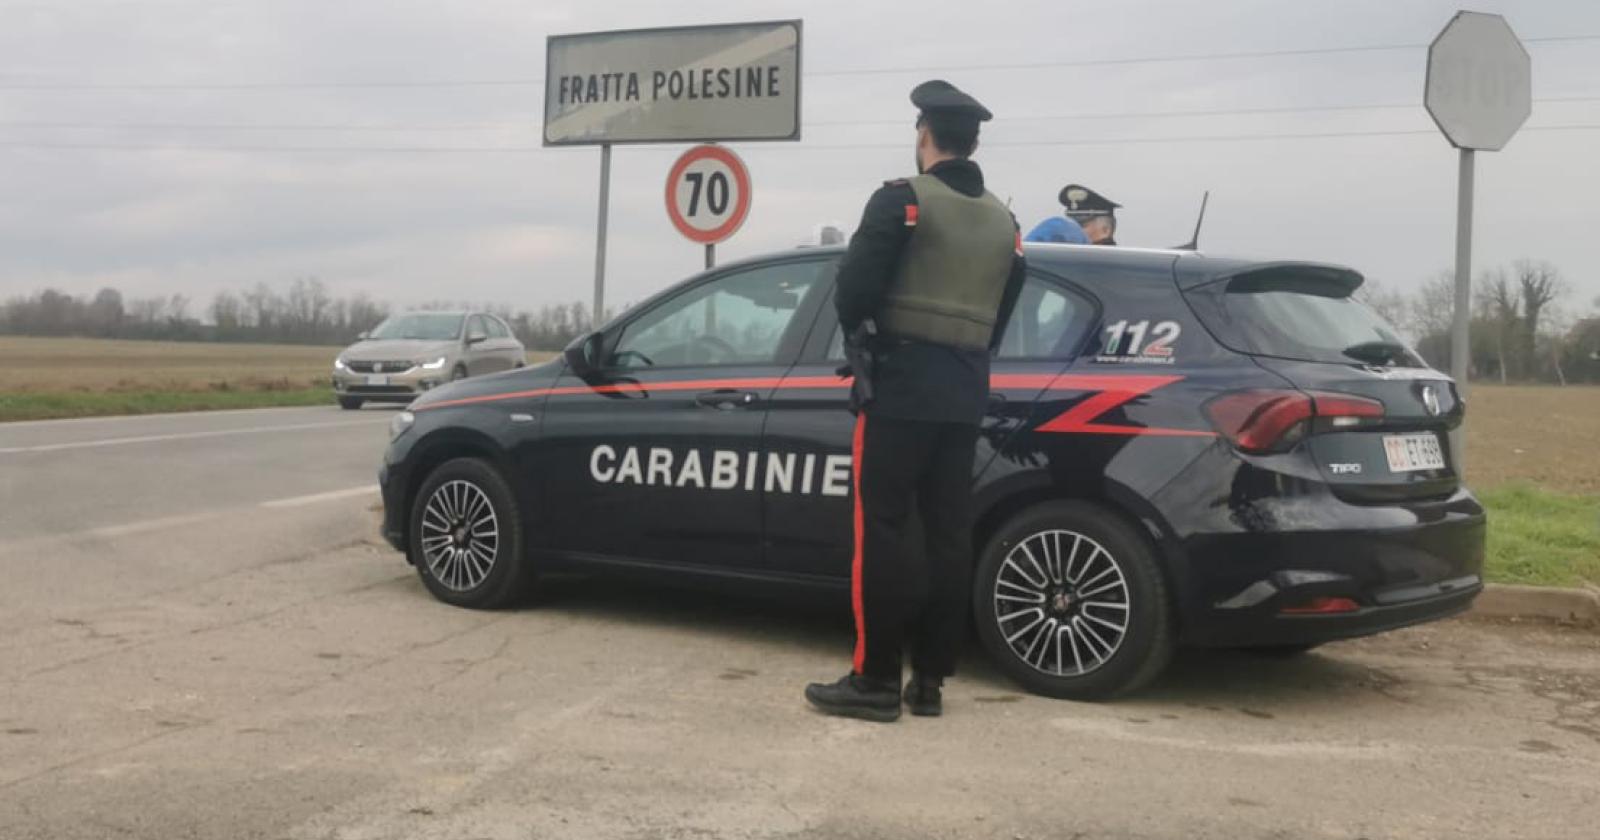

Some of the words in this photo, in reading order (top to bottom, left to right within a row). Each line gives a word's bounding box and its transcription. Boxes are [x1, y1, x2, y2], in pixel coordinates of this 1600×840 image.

[559, 72, 640, 104] FRATTA
[653, 66, 781, 101] POLESINE
[685, 171, 730, 217] 70
[1106, 320, 1181, 356] 112
[589, 444, 853, 497] CARABINIE
[1329, 463, 1362, 474] TIPO
